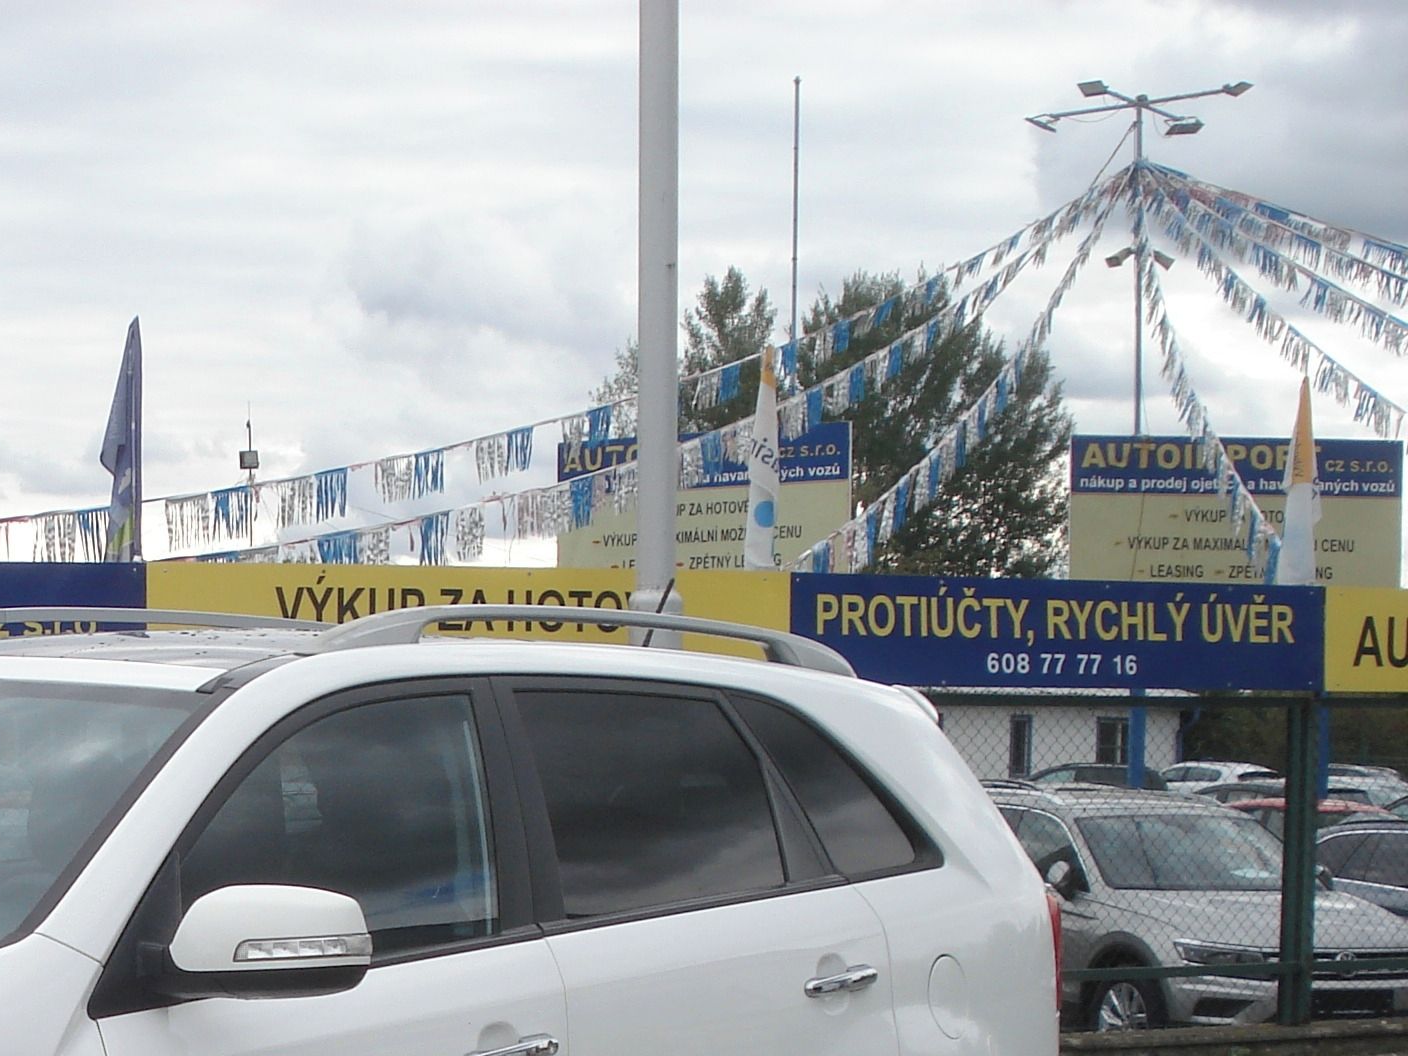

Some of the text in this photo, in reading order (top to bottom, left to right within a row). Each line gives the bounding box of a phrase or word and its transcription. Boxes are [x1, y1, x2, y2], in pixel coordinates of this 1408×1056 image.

[1325, 459, 1344, 472] cz
[1350, 458, 1393, 473] s.r.o.
[1080, 475, 1125, 491] nákup
[1128, 478, 1138, 489] a
[1141, 476, 1186, 493] prodej
[1150, 564, 1204, 578] LEASING
[816, 586, 1295, 647] PROTIÚČTY, RYCHLÝ ÚVĚR
[986, 652, 1138, 676] 608 77 77 16
